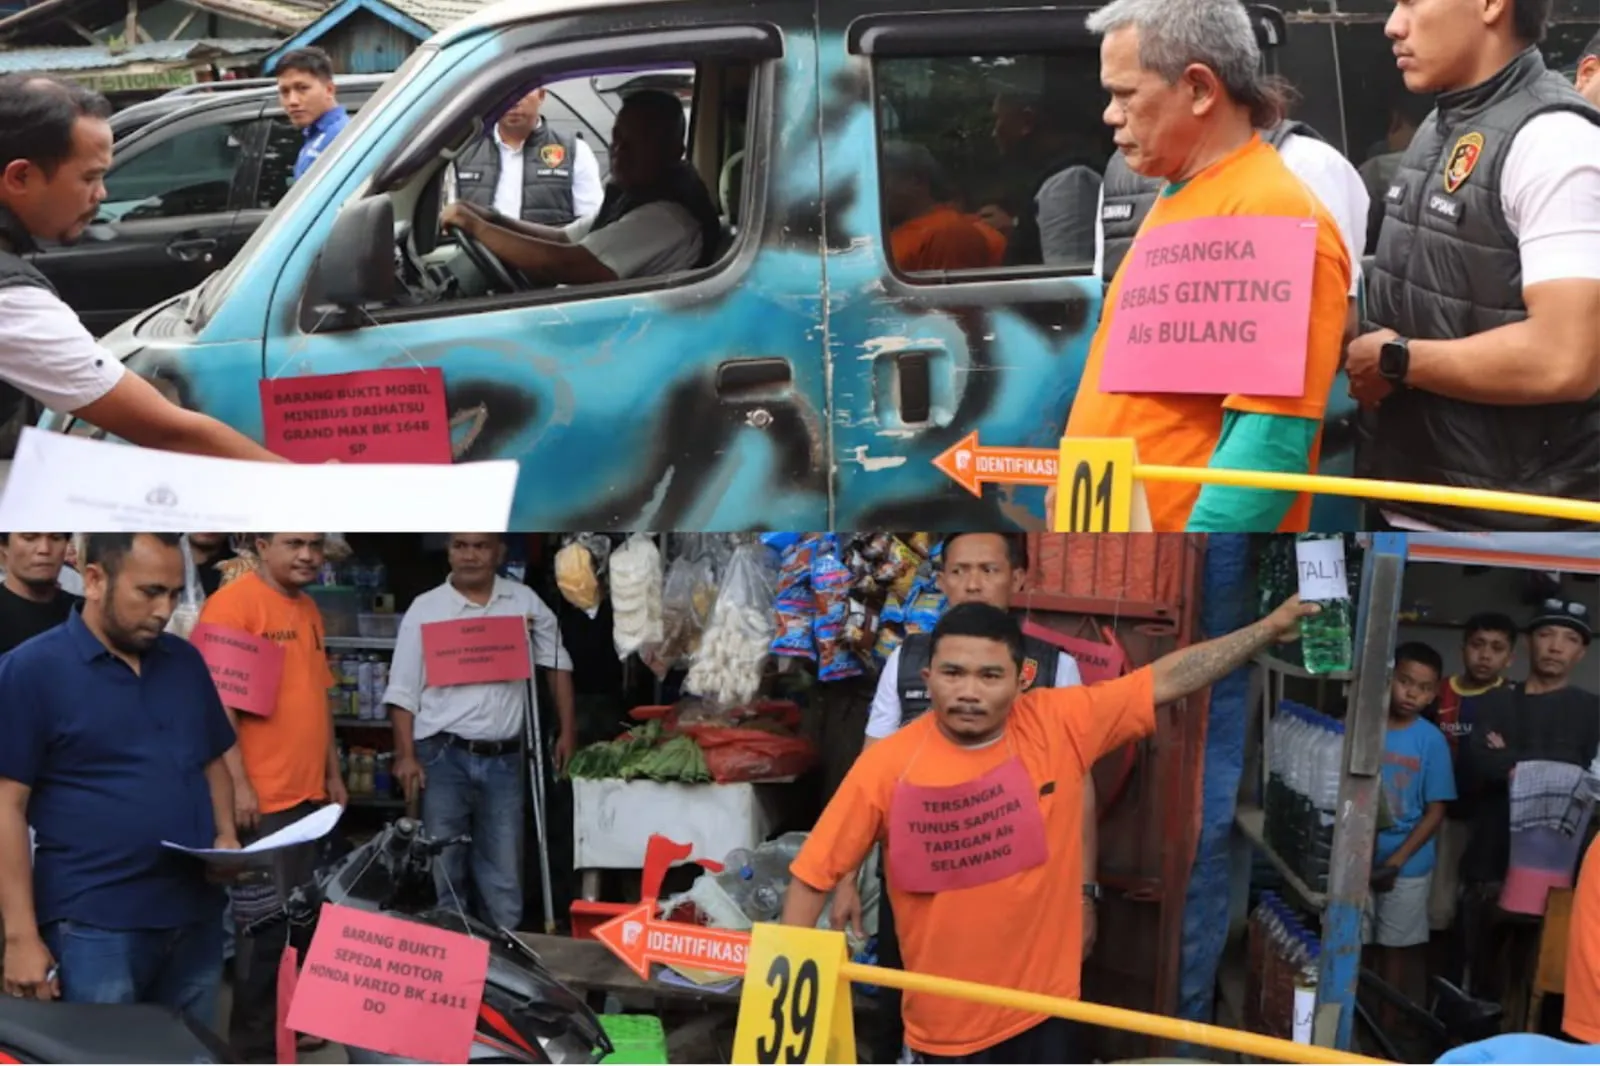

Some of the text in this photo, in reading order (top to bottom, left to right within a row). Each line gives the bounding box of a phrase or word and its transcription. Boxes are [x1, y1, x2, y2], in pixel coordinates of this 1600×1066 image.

[1144, 240, 1256, 268] TERSANGKA
[1121, 280, 1292, 311] BEBAS GINTING
[1127, 321, 1258, 345] Als BULANG
[273, 383, 431, 405] BARANG BUKTI MOBIL
[284, 402, 425, 423] MINIBUS DAIHATSU
[283, 427, 334, 442] GRAND
[338, 425, 368, 437] MAX
[372, 422, 391, 435] BK
[349, 443, 367, 455] SP
[976, 456, 1058, 475] IDENTIFIKASI
[1070, 461, 1114, 532] 01
[204, 632, 259, 654] TERSANGKA
[922, 784, 1005, 814] TERSANGKA
[908, 799, 1022, 835] YUNUS SAPUTRA
[924, 831, 992, 854] TARIGAN
[931, 844, 1012, 872] SELAWANG
[342, 926, 447, 960] BARANG BUKTI
[647, 930, 749, 965] IDENTIFIKASI
[334, 948, 444, 983] SEPEDA MOTOR
[310, 963, 468, 1010] HONDA VARIO BK 1411
[363, 998, 386, 1014] DO
[756, 955, 819, 1064] 39
